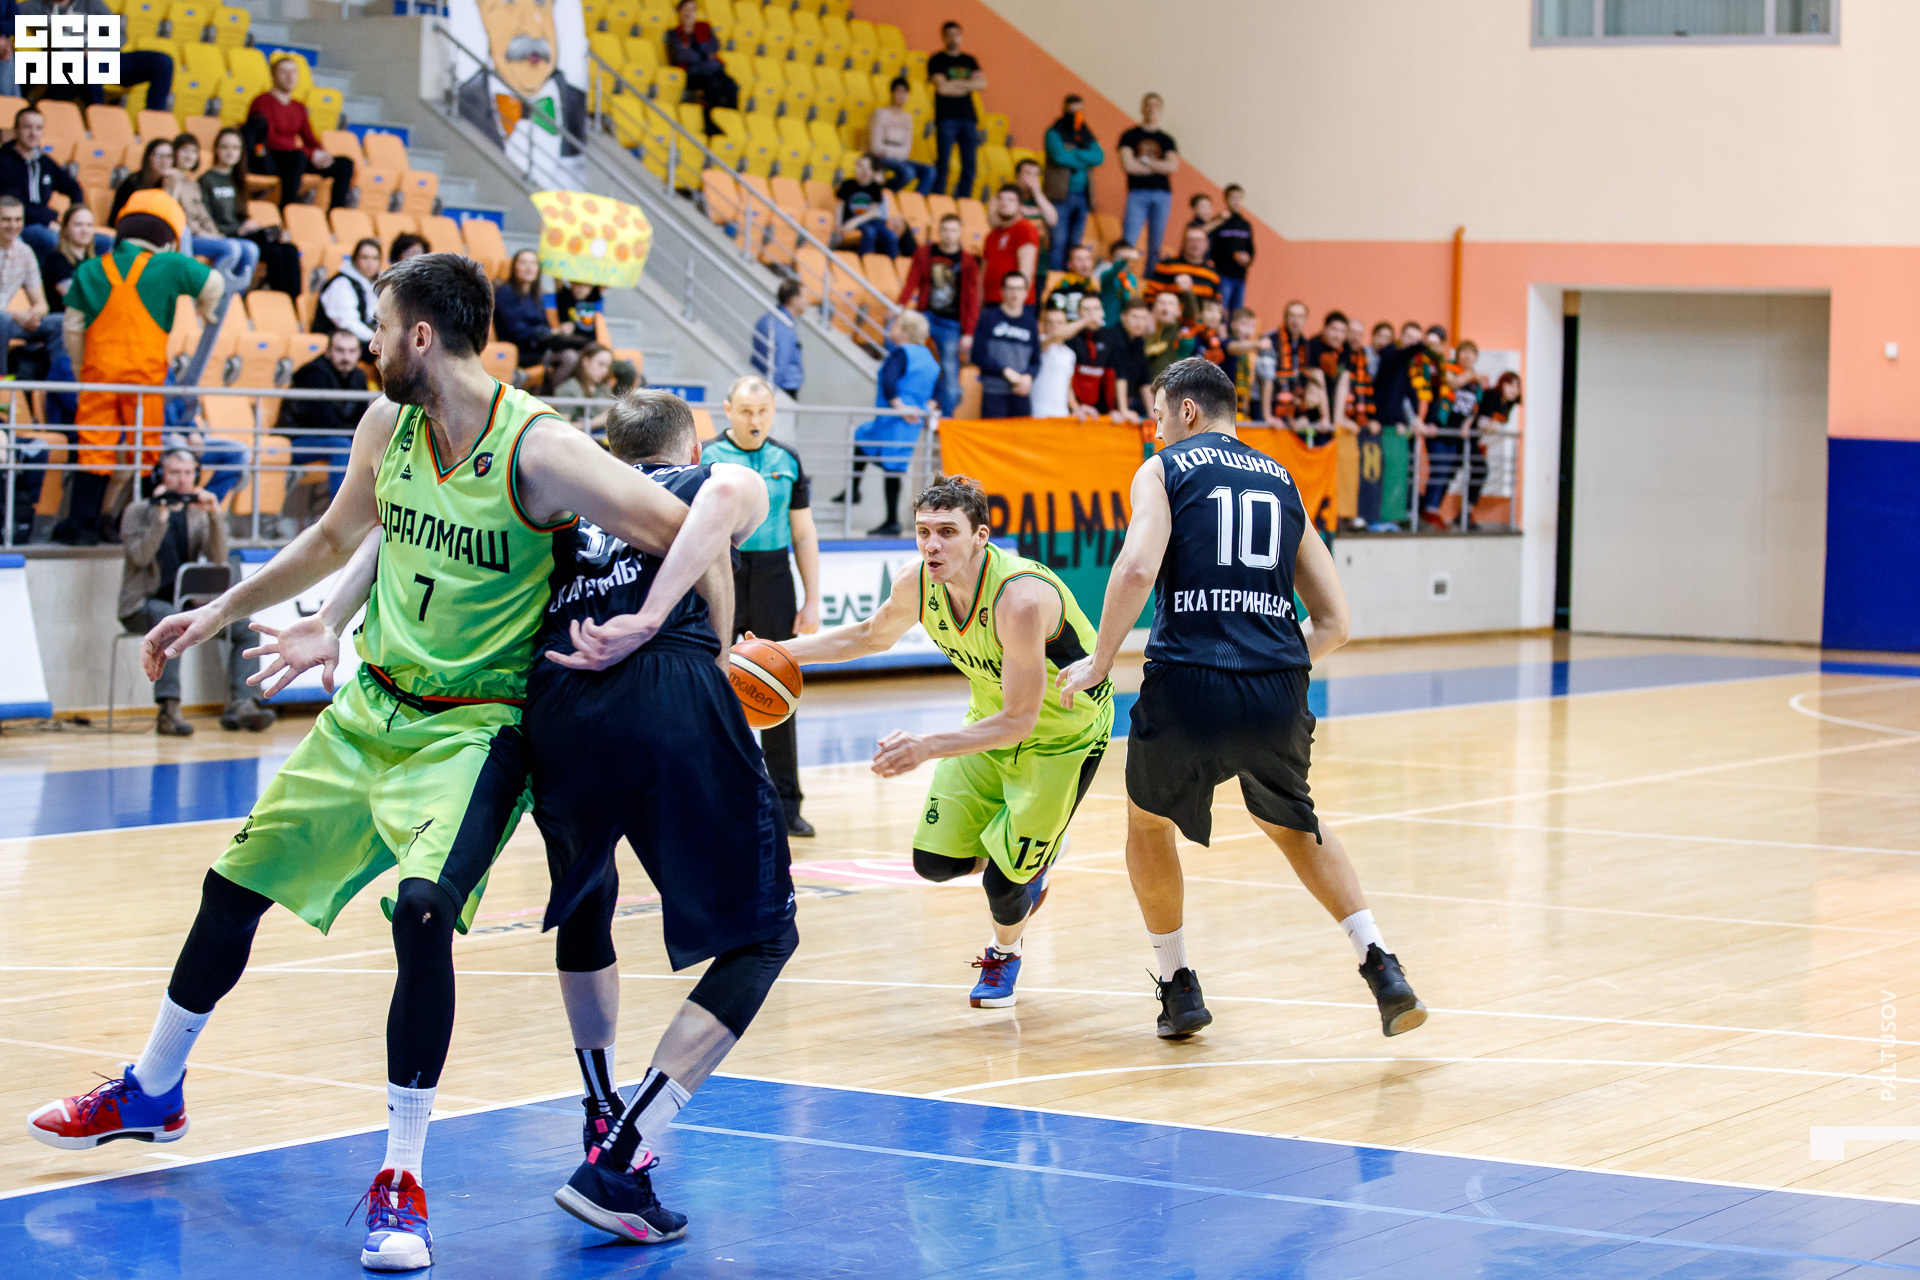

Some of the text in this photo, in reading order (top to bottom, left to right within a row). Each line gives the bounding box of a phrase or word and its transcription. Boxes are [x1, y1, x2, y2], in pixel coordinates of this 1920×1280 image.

[1172, 447, 1290, 485] КОРШУНОВ
[379, 498, 510, 573] УРАЛМАШ
[988, 490, 1130, 569] RALMA
[1206, 485, 1281, 570] 10
[414, 573, 436, 622] 7
[730, 672, 773, 708] molten
[1014, 836, 1052, 870] 13
